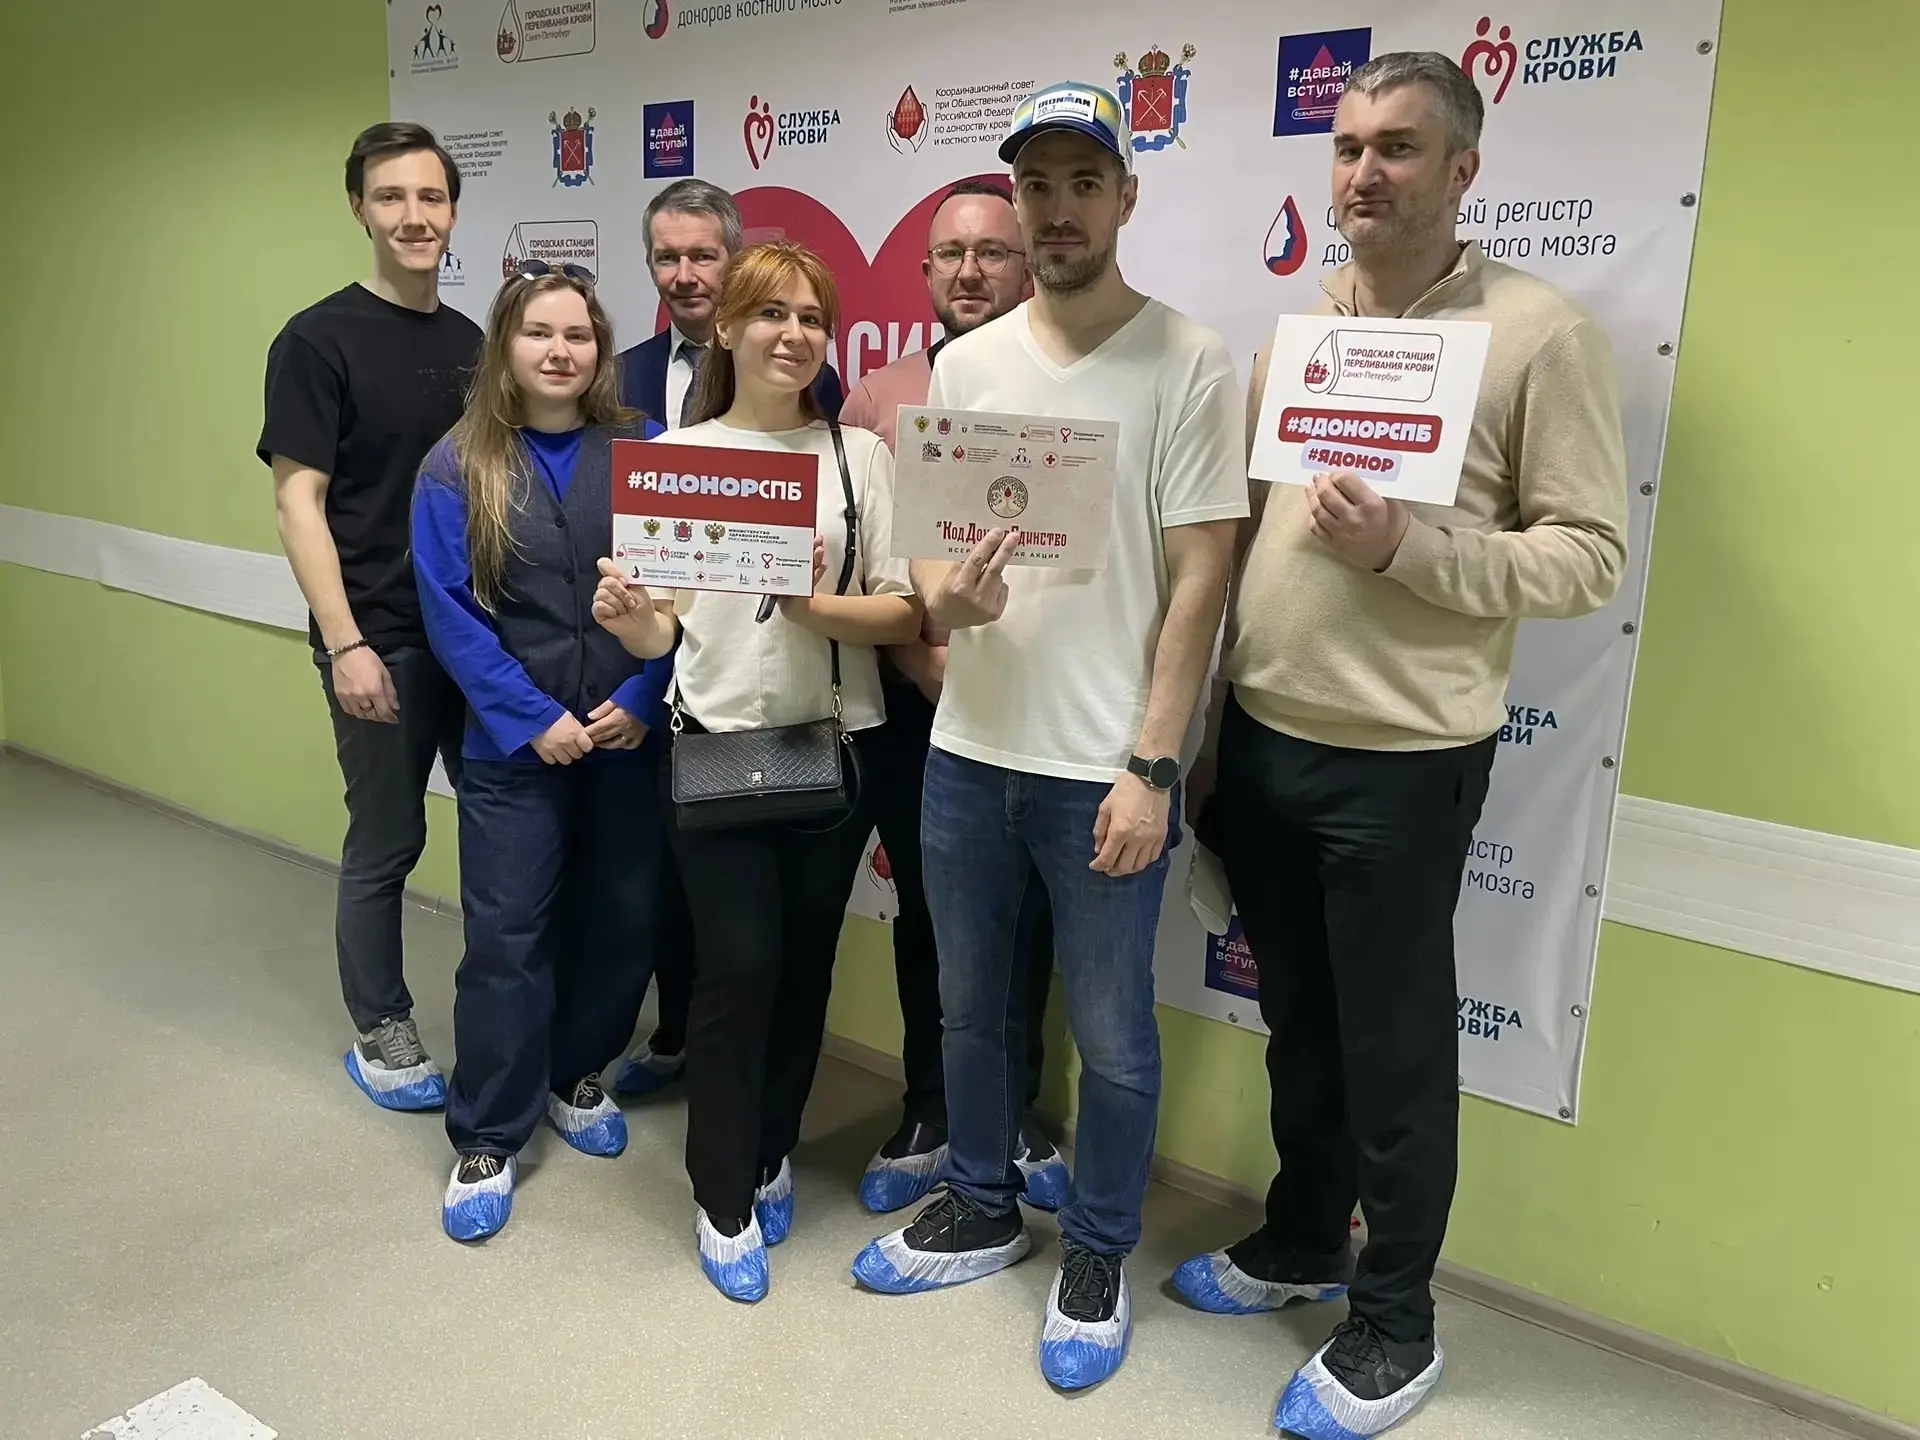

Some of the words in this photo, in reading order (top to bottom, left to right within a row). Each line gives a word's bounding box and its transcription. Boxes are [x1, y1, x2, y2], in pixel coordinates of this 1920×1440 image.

[525, 7, 560, 20] ГОРОДСКАЯ
[562, 2, 591, 14] СТАНЦИЯ
[678, 4, 731, 28] доноров
[525, 17, 568, 30] ПЕРЕЛИВАНИЯ
[570, 14, 592, 24] КРОВИ
[1526, 30, 1643, 60] СЛУЖБА
[1288, 60, 1352, 83] #давай
[1523, 56, 1616, 84] КРОВИ
[936, 82, 1009, 97] Координационный
[1011, 80, 1035, 90] совет
[935, 102, 950, 110] при
[952, 94, 1012, 108] Общественной
[1038, 96, 1091, 108] IRONMAN
[778, 110, 841, 129] СЛУЖБА
[935, 110, 982, 121] Российской
[984, 107, 1014, 118] Федера
[650, 124, 684, 139] #давай
[946, 122, 987, 133] донорству
[650, 137, 688, 151] вступай
[778, 128, 827, 146] КРОВИ
[941, 136, 977, 145] костного
[979, 134, 1004, 142] мозга
[1496, 199, 1592, 230] регистр
[530, 240, 564, 248] ГОРОДСКАЯ
[566, 238, 594, 248] СТАНЦИЯ
[1541, 234, 1616, 257] мозга
[530, 250, 572, 258] ПЕРЕЛИВАНИЯ
[574, 250, 595, 258] КРОВИ
[1346, 348, 1394, 358] ГОРОДСКАЯ
[1396, 351, 1436, 362] СТАНЦИЯ
[1344, 359, 1402, 370] ПЕРЕЛИВАНИЯ
[1404, 362, 1434, 372] КРОВИ
[1342, 370, 1403, 382] Санкт-Петербург
[1286, 416, 1432, 443] #ЯДОНОРСПБ
[1308, 447, 1394, 472] #ЯДОНОР
[628, 470, 802, 501] #ЯДОНОРСПБ
[1468, 870, 1534, 900] мозга
[1216, 951, 1257, 970] вступ
